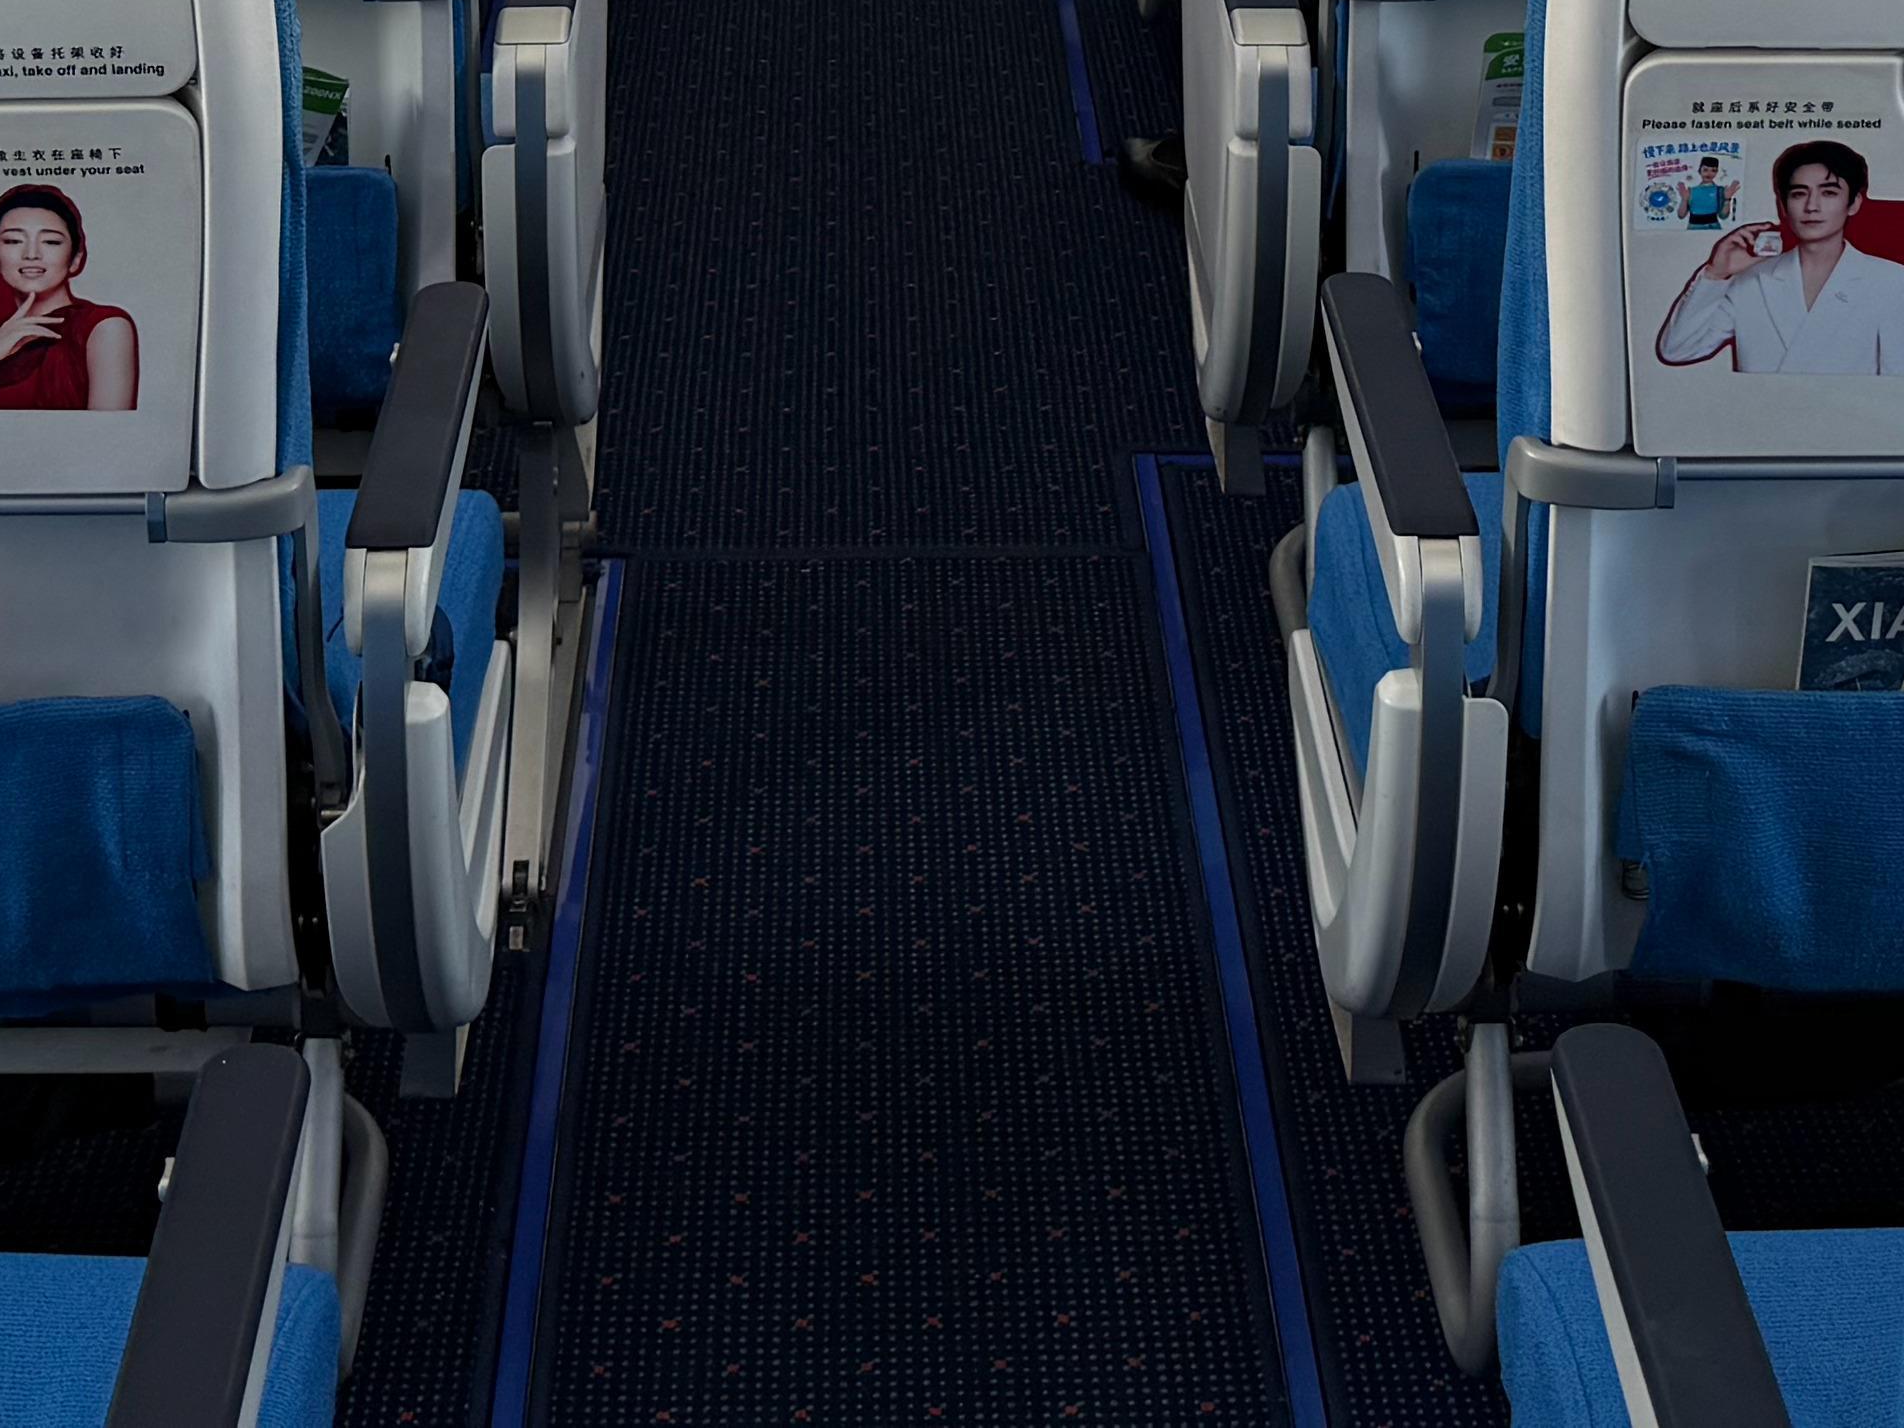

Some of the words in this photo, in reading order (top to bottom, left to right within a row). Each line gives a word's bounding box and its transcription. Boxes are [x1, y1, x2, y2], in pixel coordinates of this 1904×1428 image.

[2, 166, 32, 177] vest
[35, 165, 75, 176] under
[79, 165, 112, 178] your
[115, 163, 145, 175] seat
